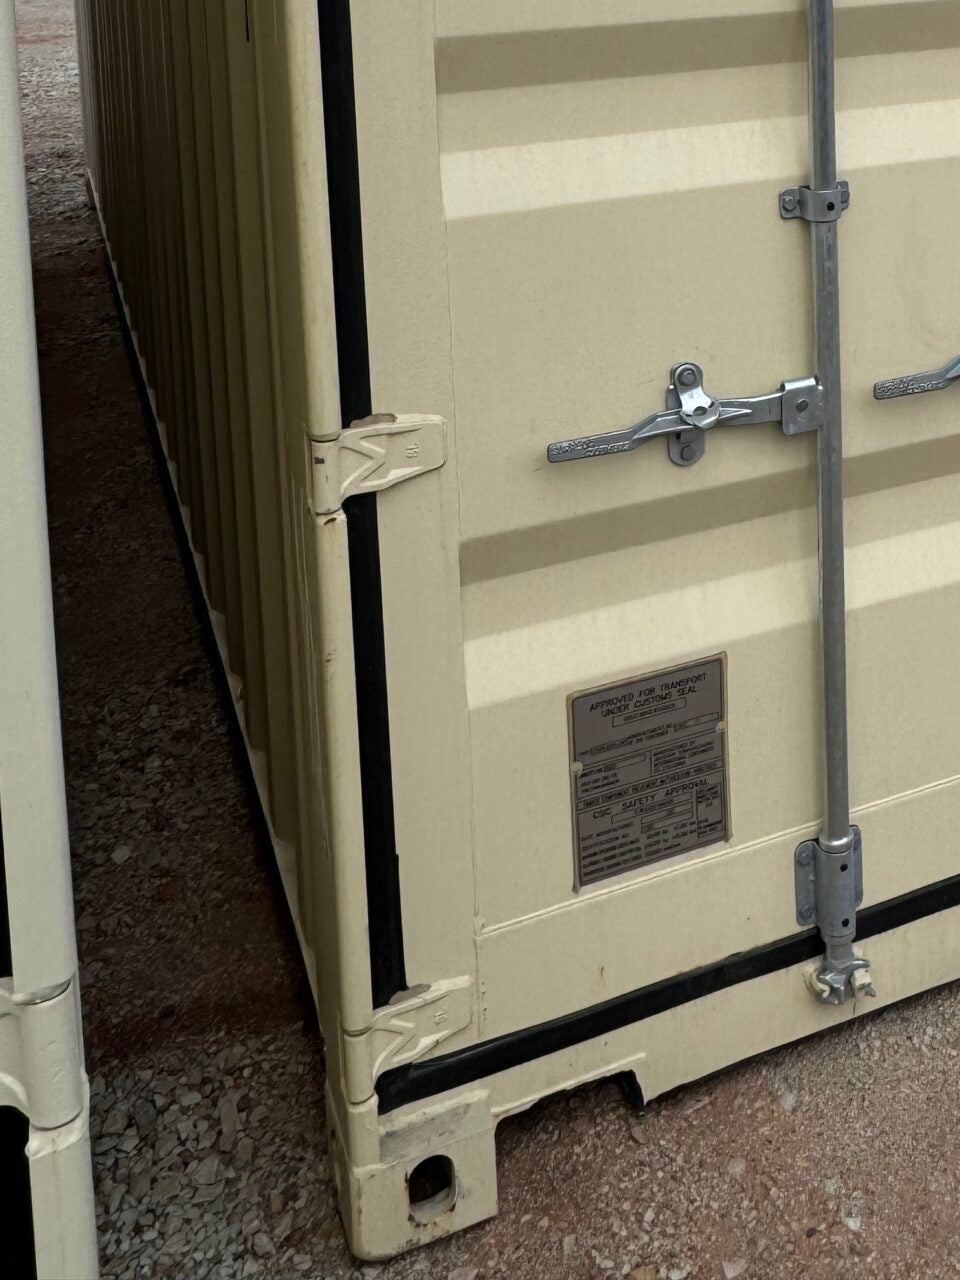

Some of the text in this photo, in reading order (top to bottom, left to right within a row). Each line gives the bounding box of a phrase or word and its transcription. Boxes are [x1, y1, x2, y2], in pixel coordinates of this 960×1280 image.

[589, 692, 634, 713] APPROVED
[638, 686, 656, 698] FOR
[660, 672, 708, 692] TRANSPORT
[601, 703, 630, 718] UNDER
[633, 691, 673, 709] CUSTOMS
[676, 685, 698, 696] SEAL
[592, 807, 612, 820] CSC
[621, 793, 657, 811] SAFETY
[664, 778, 710, 797] APPROVAL
